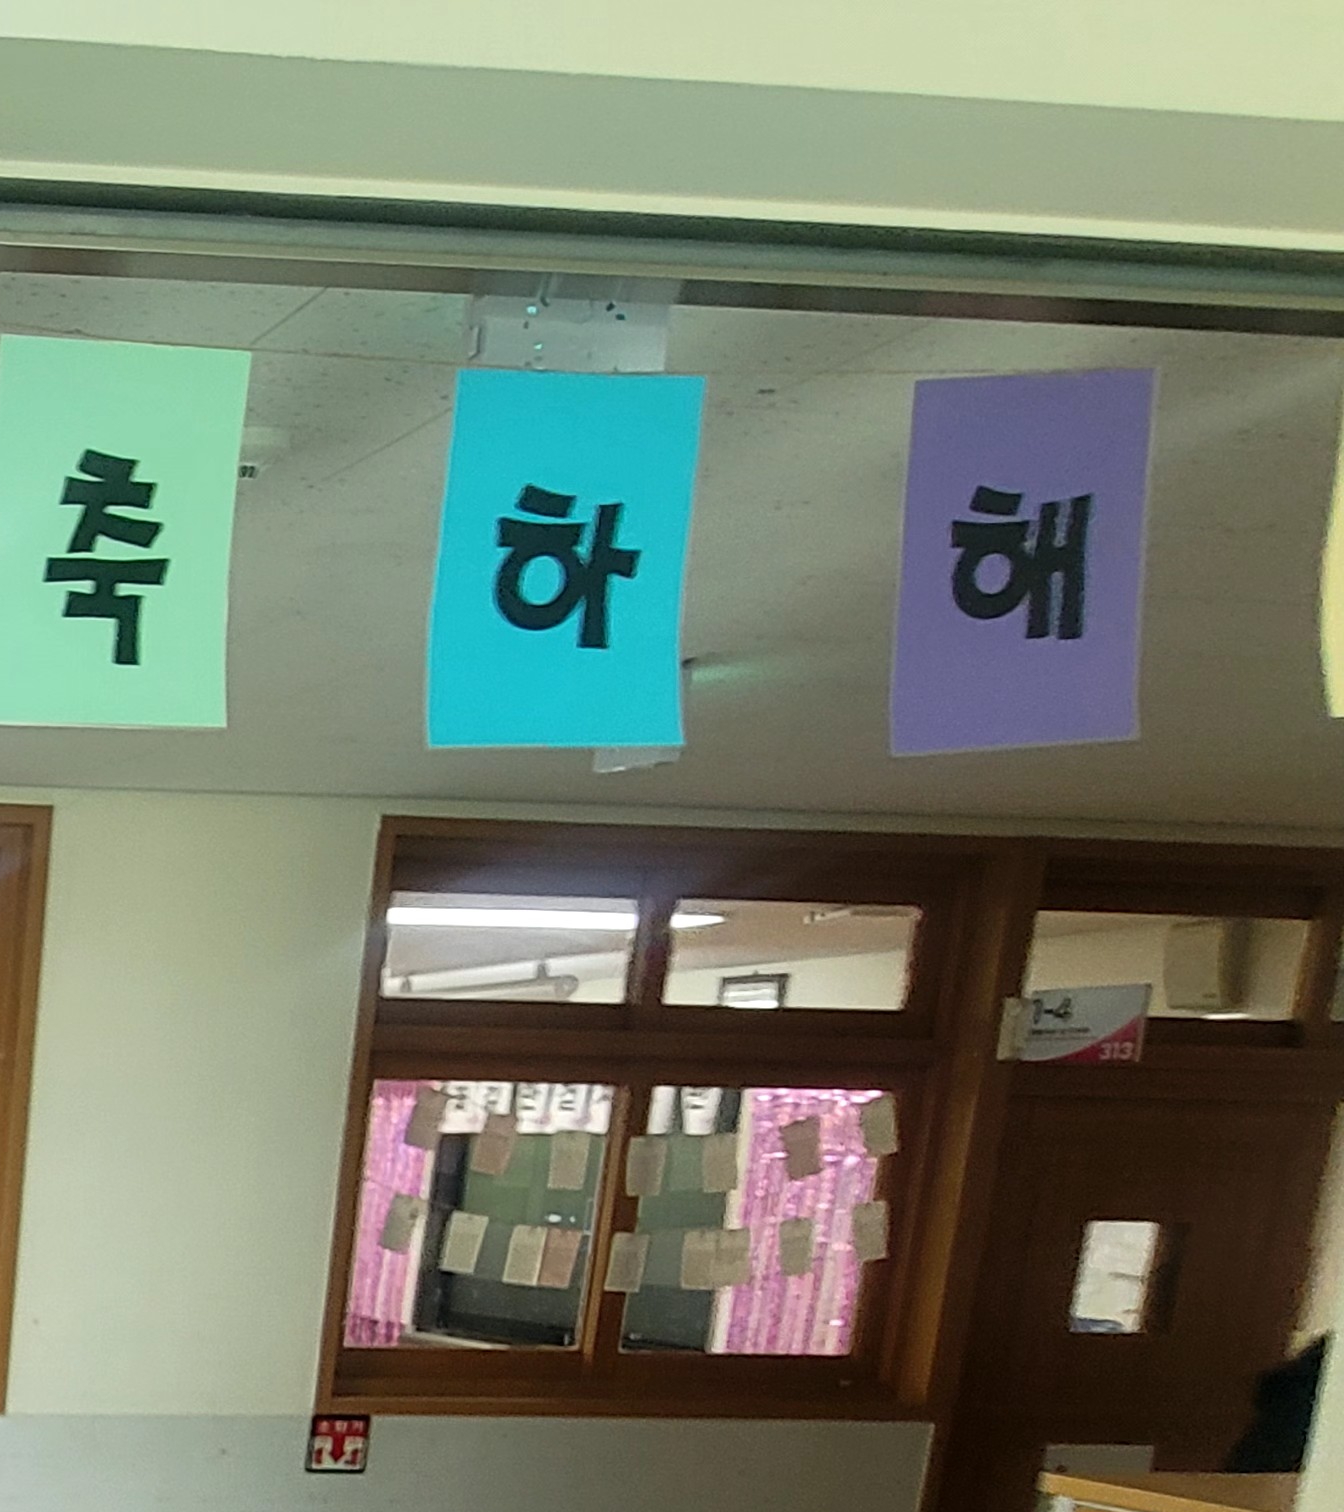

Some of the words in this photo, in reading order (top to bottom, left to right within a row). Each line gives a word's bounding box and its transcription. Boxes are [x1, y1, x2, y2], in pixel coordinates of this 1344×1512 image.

[44, 449, 170, 666] 축
[495, 483, 641, 650] 하
[950, 485, 1094, 640] 해
[1099, 1041, 1133, 1061] 313
